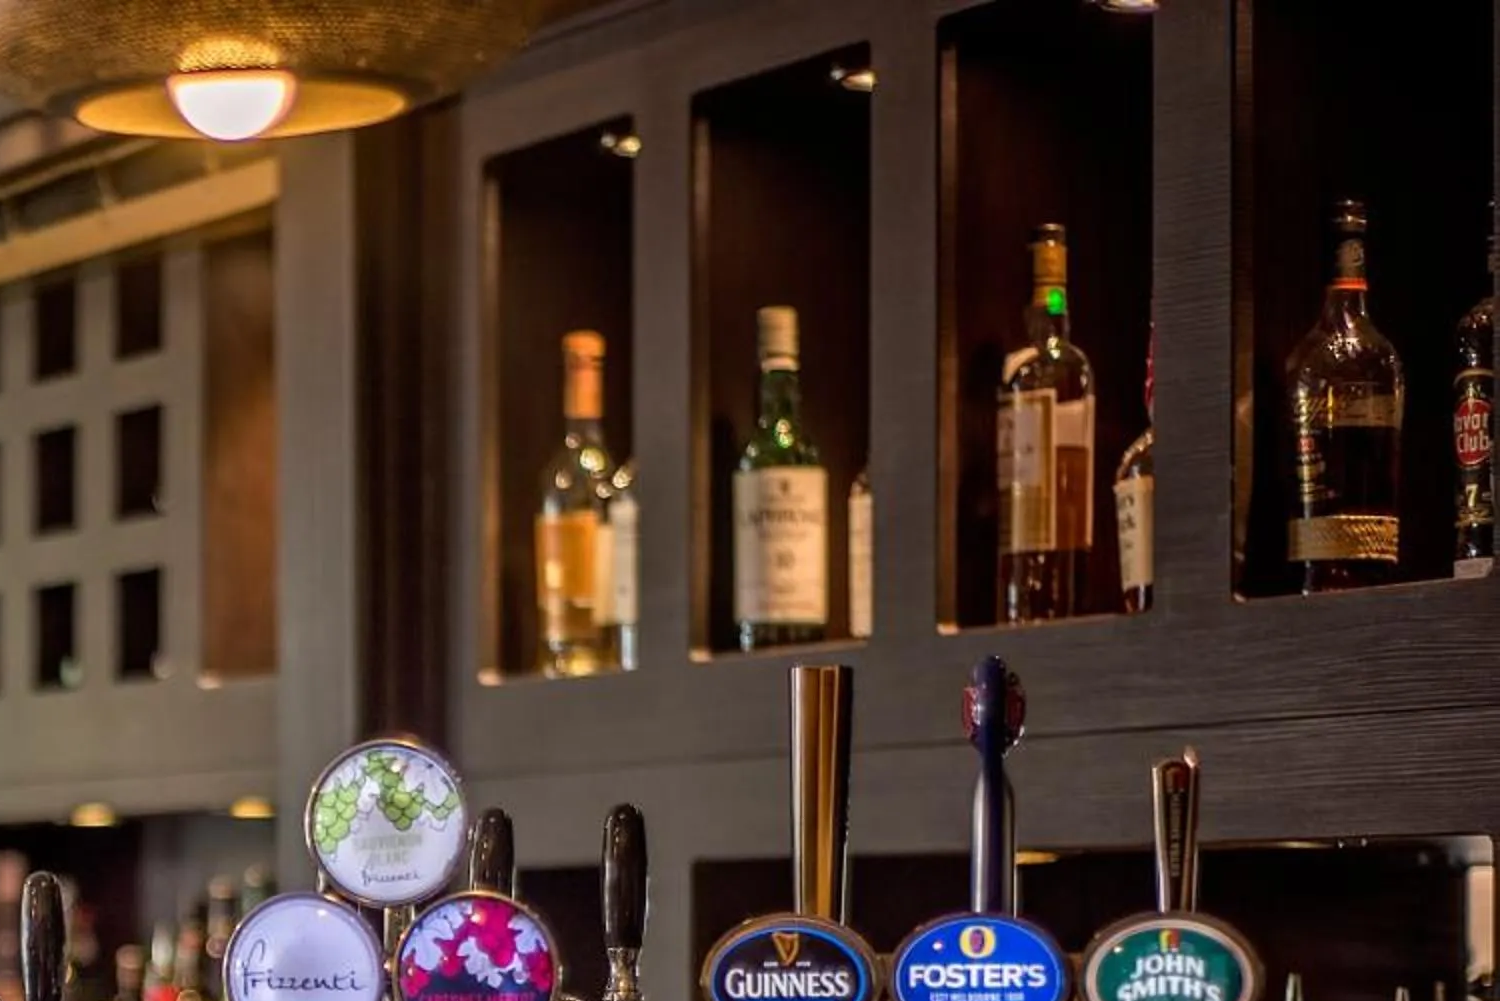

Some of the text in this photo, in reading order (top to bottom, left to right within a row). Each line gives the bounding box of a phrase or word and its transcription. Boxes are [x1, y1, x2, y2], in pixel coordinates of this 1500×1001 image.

[1456, 430, 1490, 453] Club
[1465, 483, 1479, 507] 7
[908, 963, 1047, 988] FOSTER'S
[1129, 953, 1205, 979] JOHN
[724, 968, 850, 999] GUINNESS
